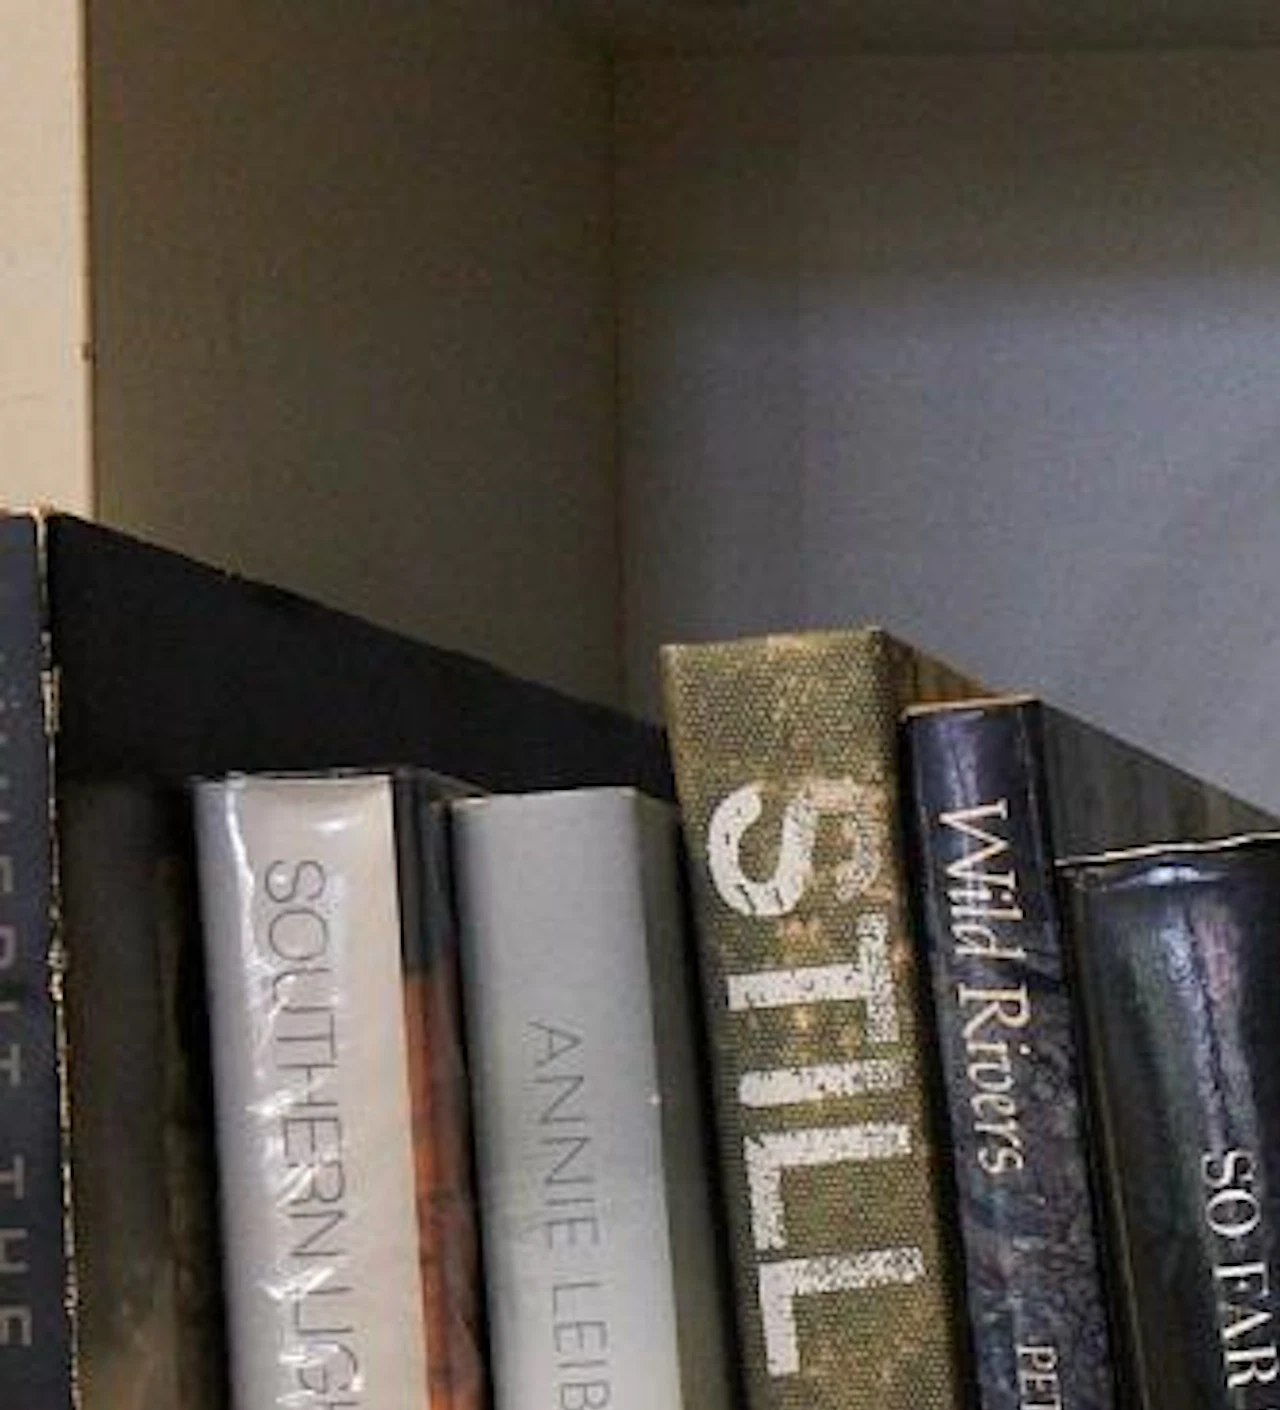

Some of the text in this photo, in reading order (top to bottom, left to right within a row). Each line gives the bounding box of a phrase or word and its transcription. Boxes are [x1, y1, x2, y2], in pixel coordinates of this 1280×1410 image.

[266, 860, 347, 1259] SOUTHERN
[529, 1019, 604, 1252] ANNIE
[707, 777, 923, 1377] STILL
[940, 801, 1031, 1176] Wild Rivers
[1200, 1149, 1261, 1237] SO
[1212, 1261, 1280, 1389] FAR
